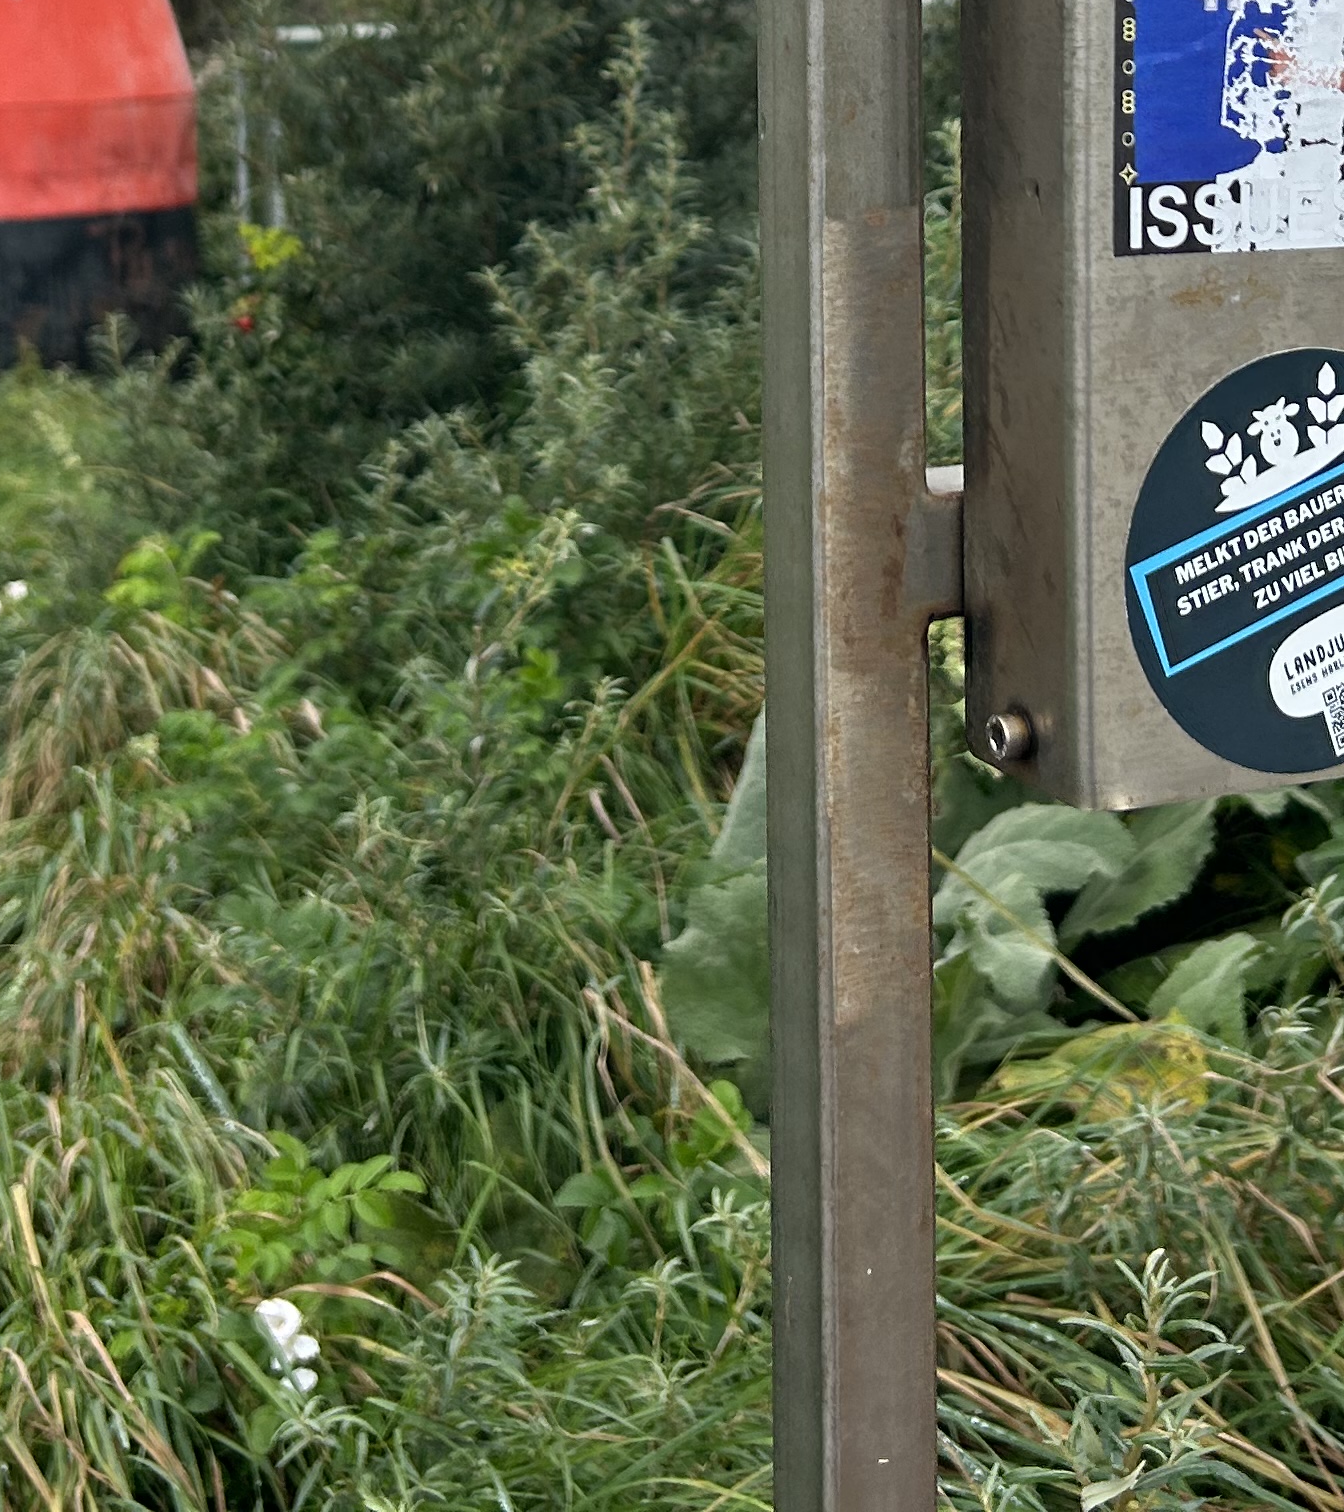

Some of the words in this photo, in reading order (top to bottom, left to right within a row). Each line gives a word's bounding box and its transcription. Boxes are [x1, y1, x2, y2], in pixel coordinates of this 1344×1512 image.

[1174, 536, 1241, 585] MELKT
[1244, 516, 1285, 551] DER
[1176, 574, 1240, 617] STIER,
[1239, 536, 1311, 586] TRANK
[1253, 579, 1281, 610] ZU
[1280, 559, 1326, 594] VIEL
[1291, 672, 1318, 695] ESENS
